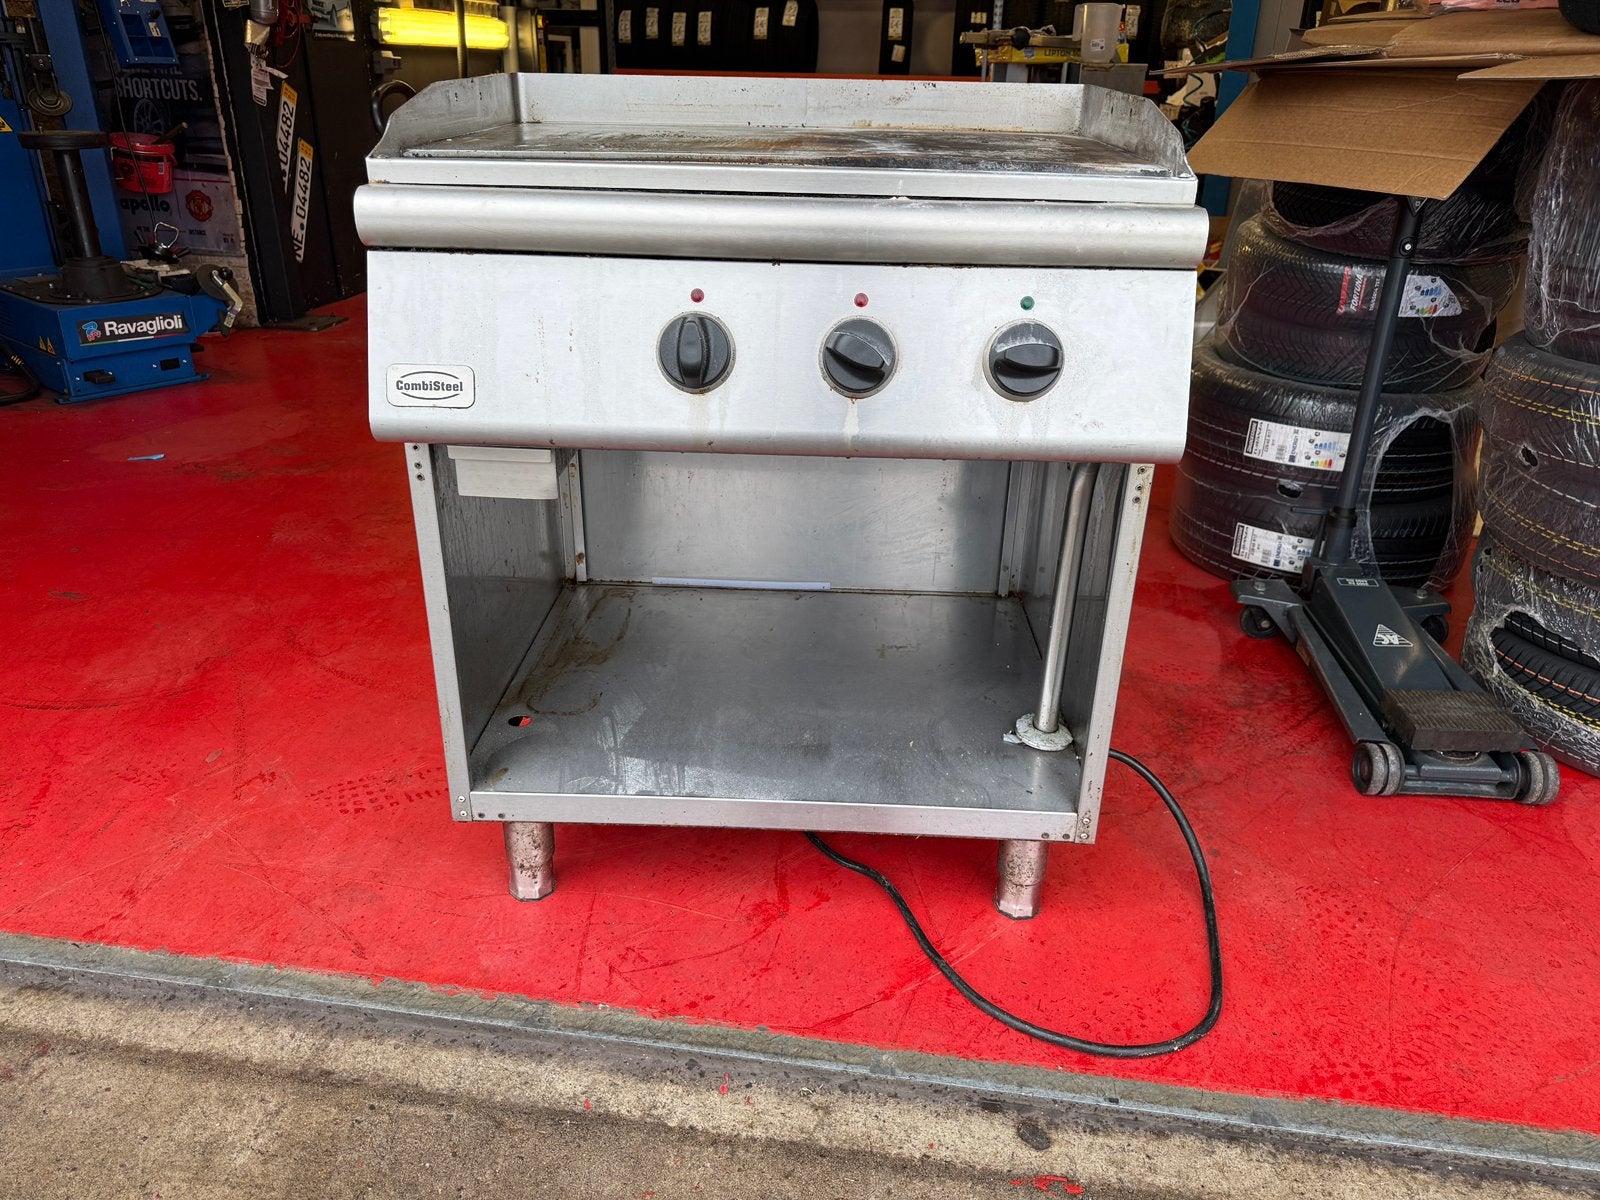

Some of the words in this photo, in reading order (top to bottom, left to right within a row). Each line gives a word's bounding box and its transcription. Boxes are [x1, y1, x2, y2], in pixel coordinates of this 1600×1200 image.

[120, 195, 170, 214] apollo
[1350, 274, 1364, 311] FORTUNA
[104, 315, 182, 335] Ravaglioli
[396, 380, 463, 391] CombiSteel
